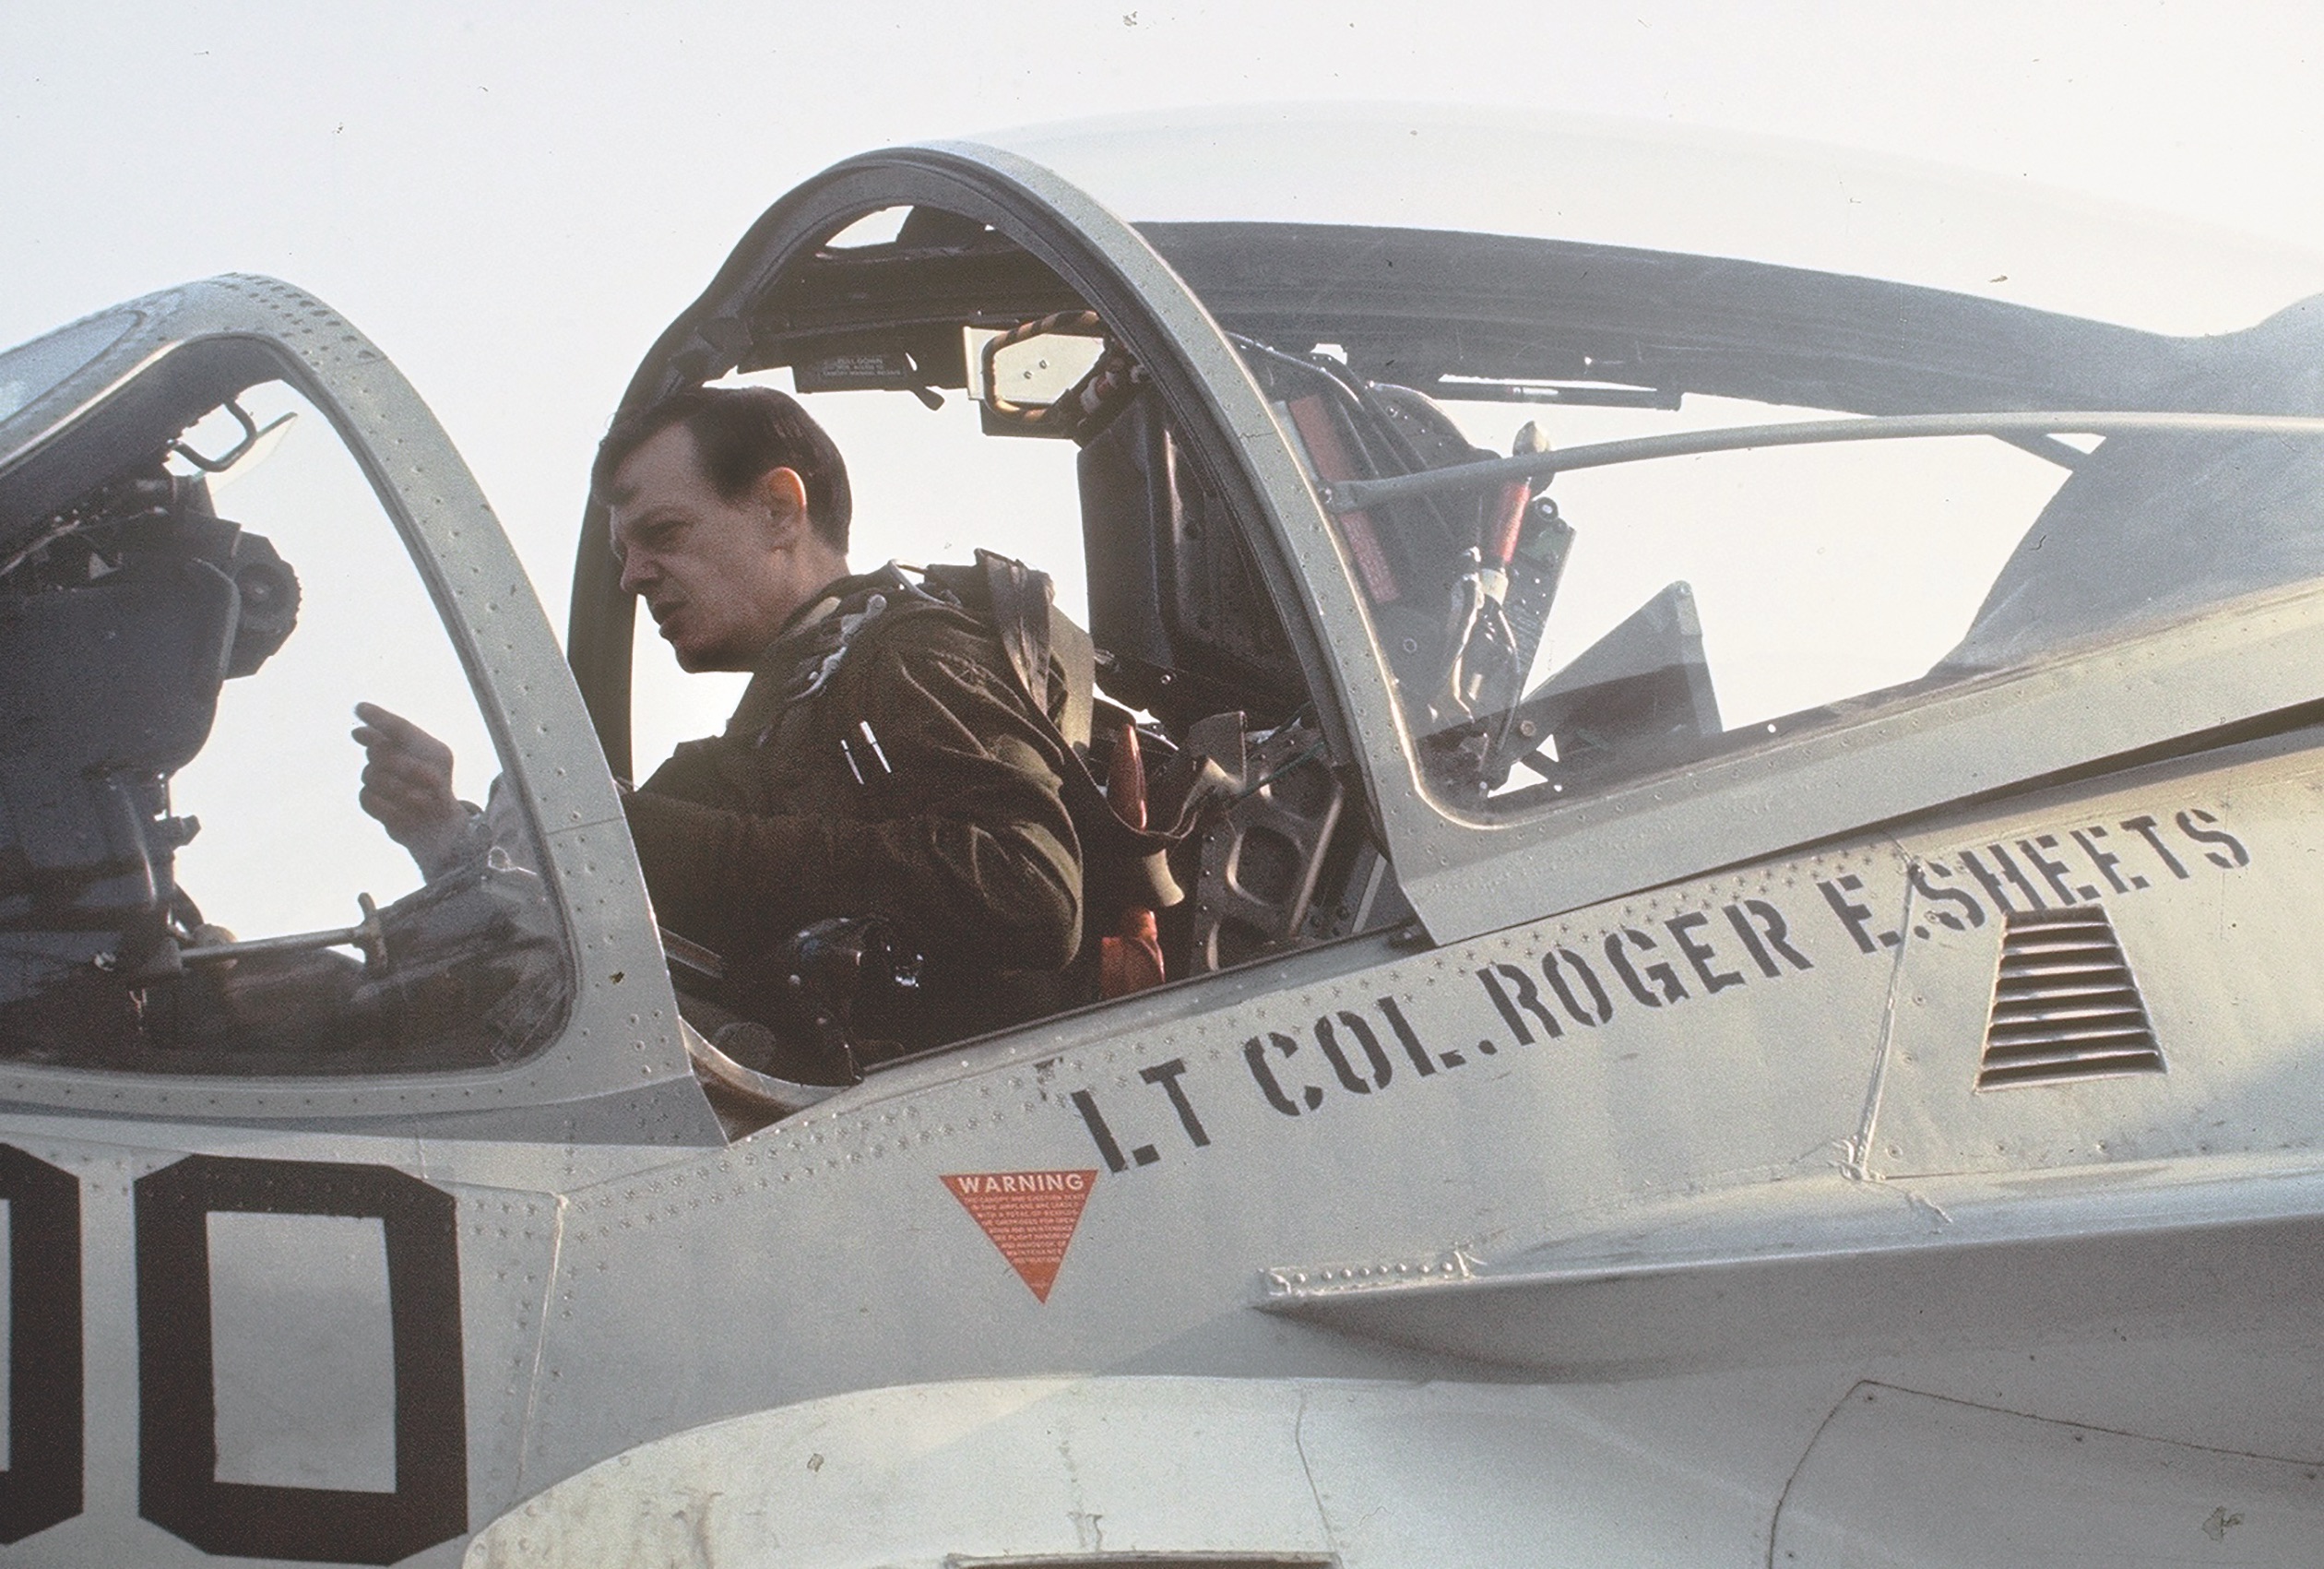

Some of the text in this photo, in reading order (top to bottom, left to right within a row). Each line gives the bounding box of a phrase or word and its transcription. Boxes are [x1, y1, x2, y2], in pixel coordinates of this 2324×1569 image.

[1070, 1057, 1211, 1173] LT
[957, 1173, 1084, 1194] WARNING
[0, 1142, 468, 1566] 0
